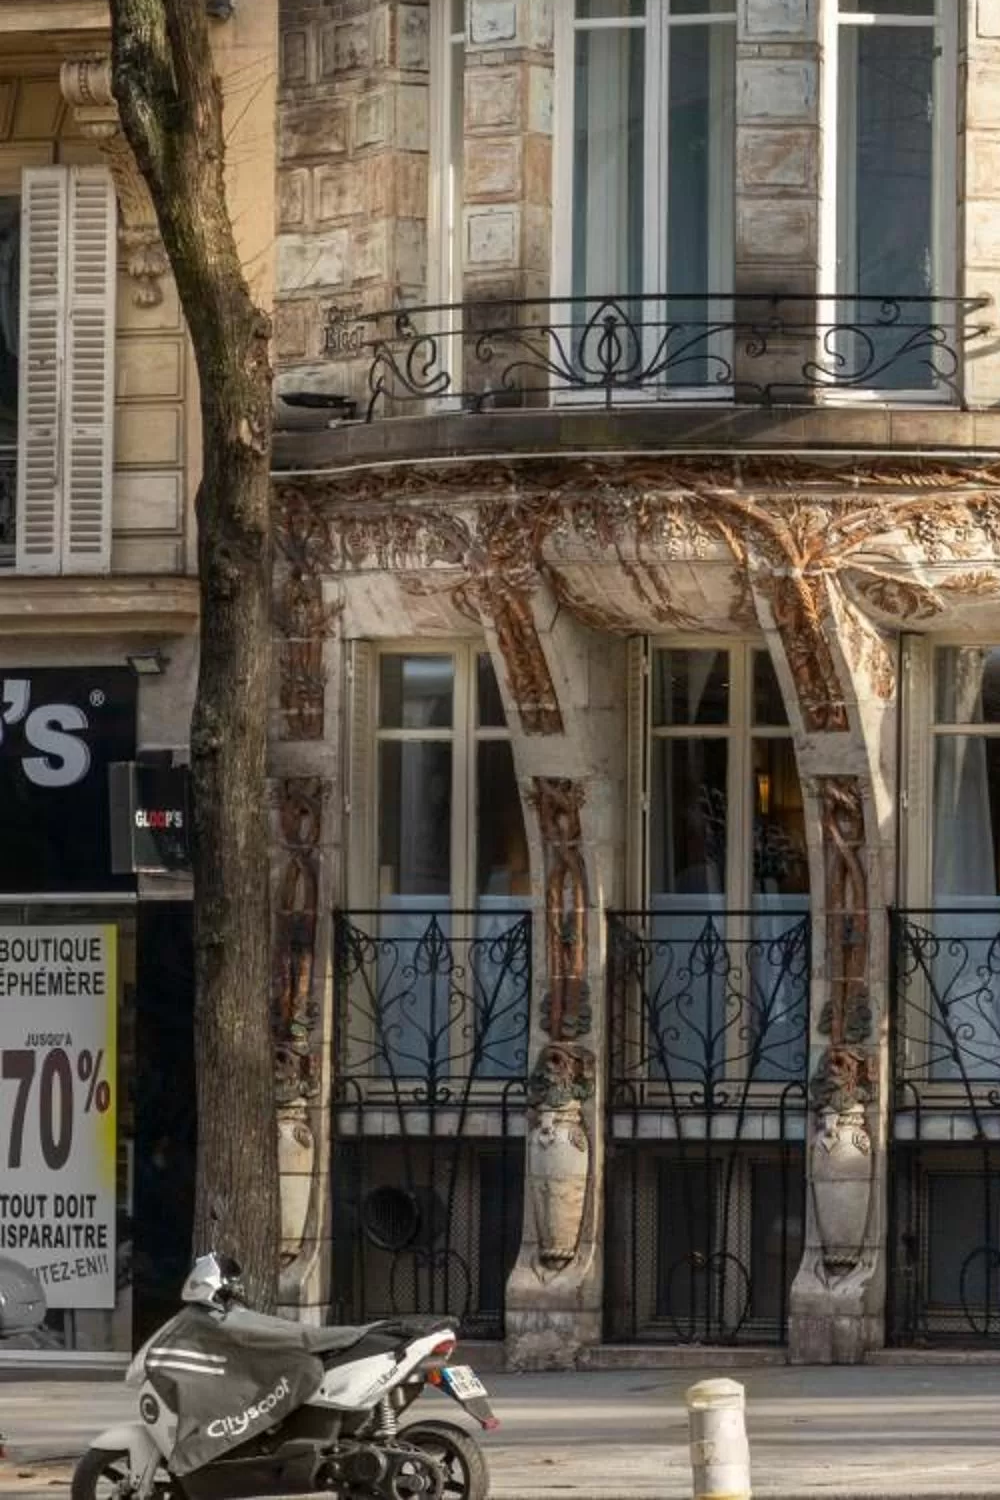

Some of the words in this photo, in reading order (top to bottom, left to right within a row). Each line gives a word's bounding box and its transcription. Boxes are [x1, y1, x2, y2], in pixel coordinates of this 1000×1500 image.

[0, 679, 91, 788] 'S
[0, 937, 102, 963] BOUTIQUE
[2, 1047, 111, 1172] 70%
[0, 1193, 48, 1219] TOUT
[54, 1193, 97, 1219] DOIT
[1, 1223, 108, 1249] ISPARAITRE
[34, 1253, 110, 1285] ITEZ-EN!!
